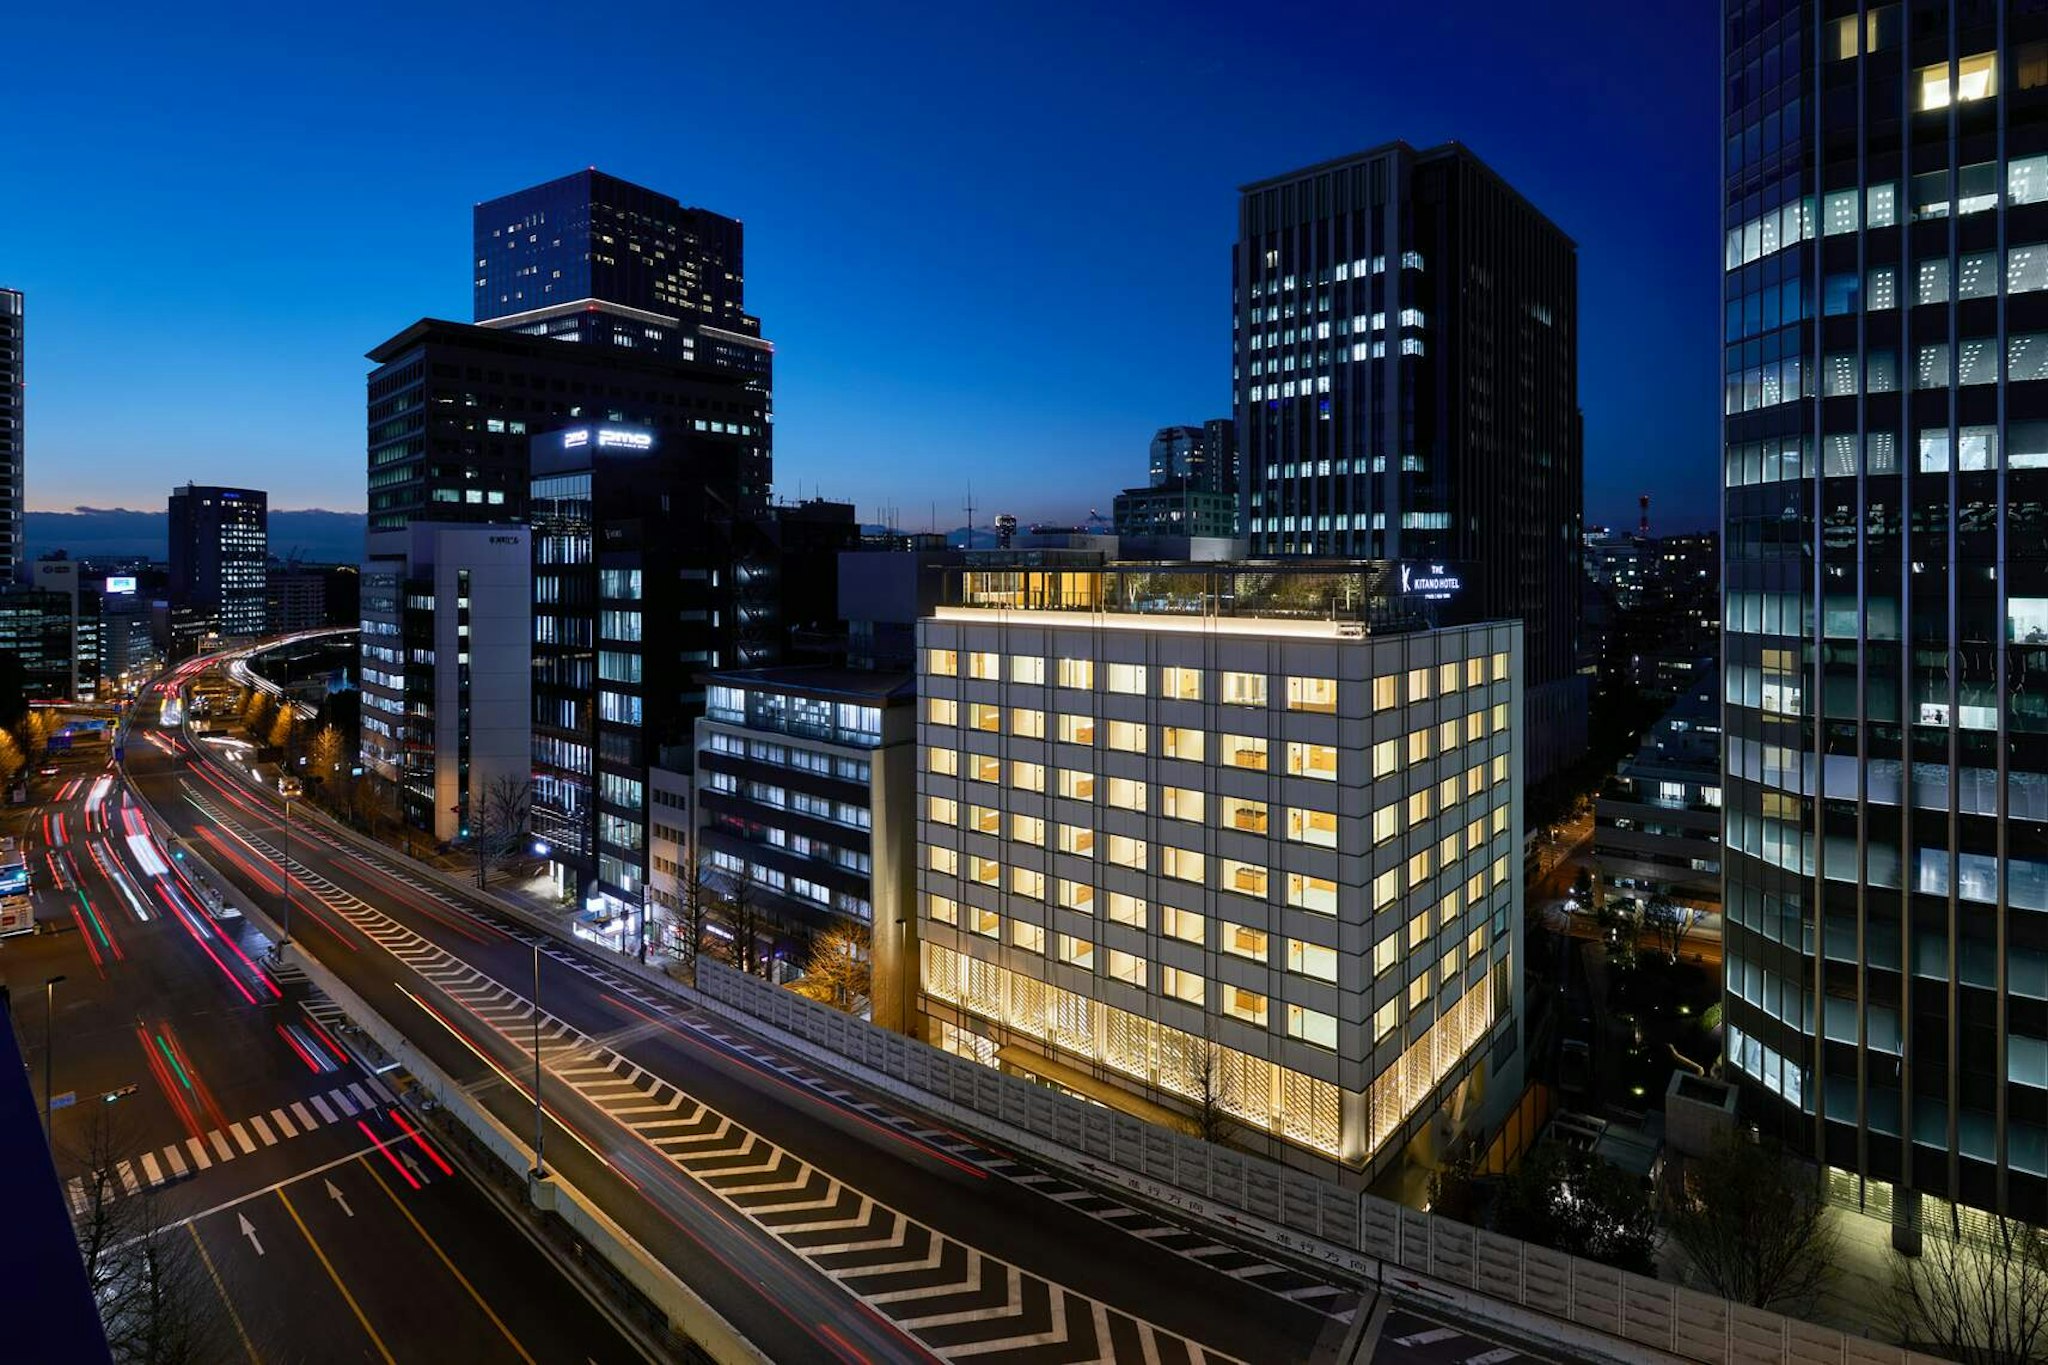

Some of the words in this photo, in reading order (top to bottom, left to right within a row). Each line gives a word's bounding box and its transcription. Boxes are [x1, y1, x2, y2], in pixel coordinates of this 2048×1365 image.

[1431, 565, 1444, 574] THE
[1414, 578, 1439, 589] KITANO
[1439, 578, 1460, 589] HOTEL
[1276, 1232, 1366, 1272] 進行方向
